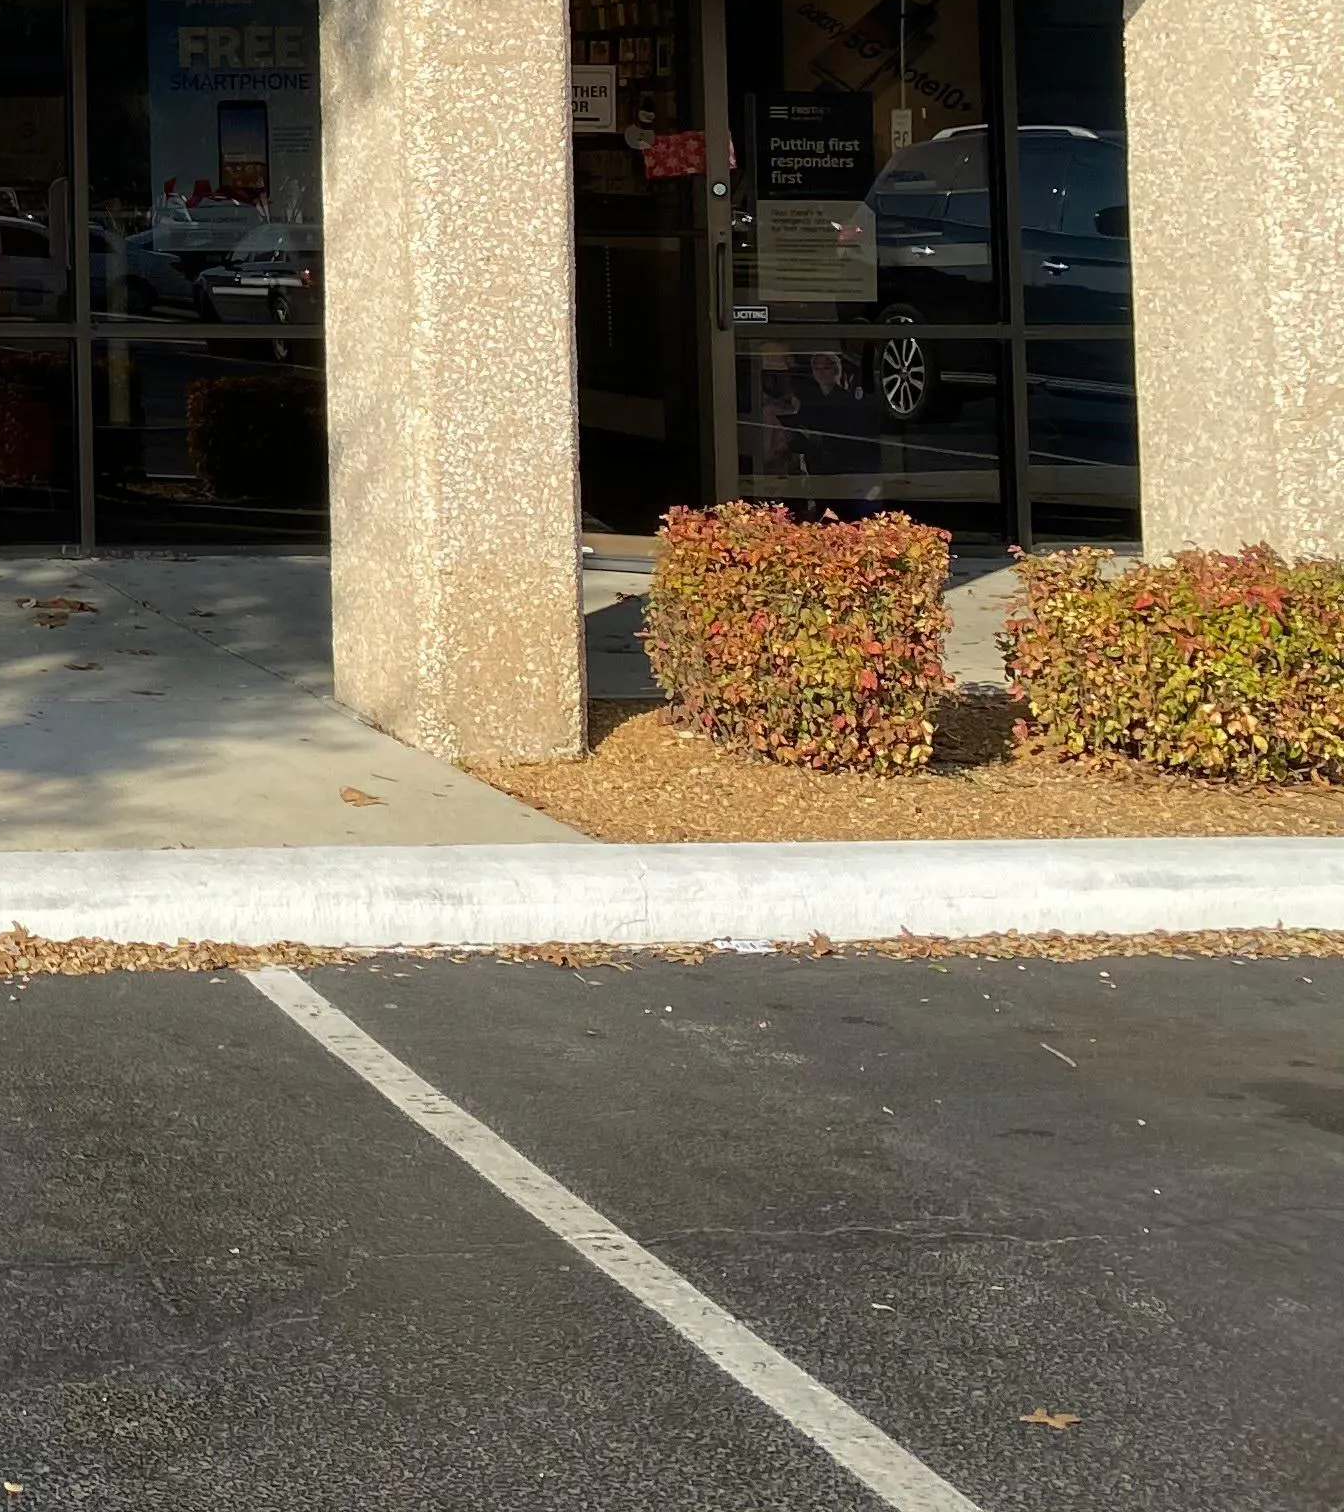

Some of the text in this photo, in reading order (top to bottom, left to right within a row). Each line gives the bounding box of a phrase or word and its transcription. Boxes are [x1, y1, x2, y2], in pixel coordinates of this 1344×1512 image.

[178, 25, 306, 68] FREE
[170, 73, 312, 91] SMARTPHONE
[770, 137, 861, 153] Putting first
[771, 155, 855, 171] responders
[771, 170, 804, 185] first
